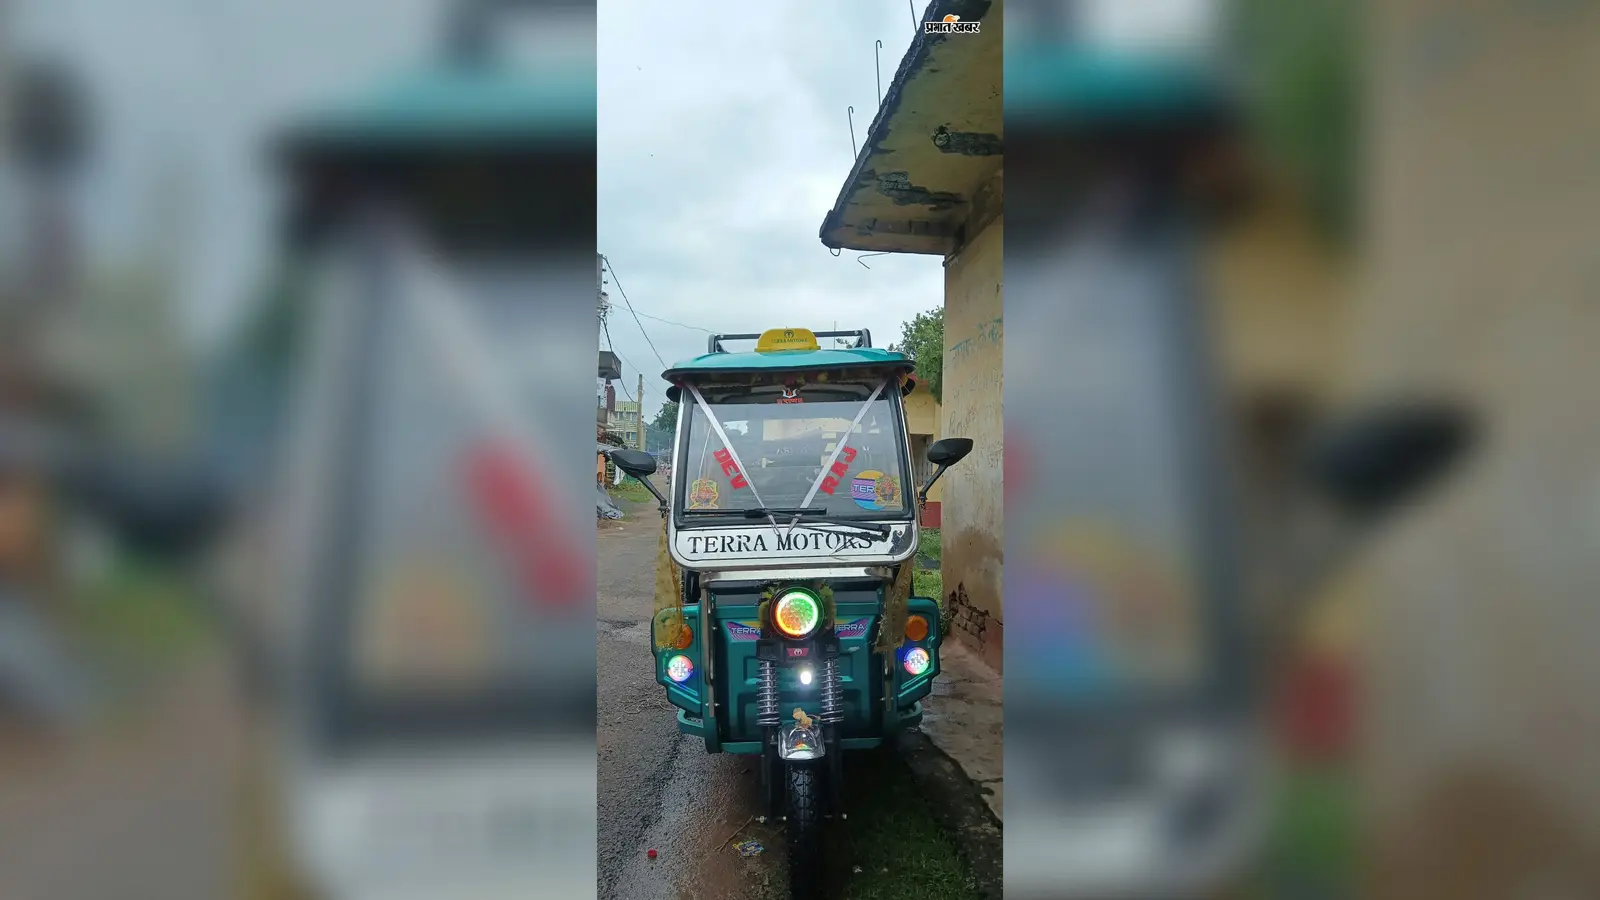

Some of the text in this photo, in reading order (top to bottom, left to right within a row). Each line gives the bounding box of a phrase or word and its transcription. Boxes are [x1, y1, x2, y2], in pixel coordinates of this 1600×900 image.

[713, 447, 749, 490] DEV
[821, 446, 857, 496] RAJ
[853, 484, 876, 493] TER
[687, 532, 873, 554] TERRA MOTORS
